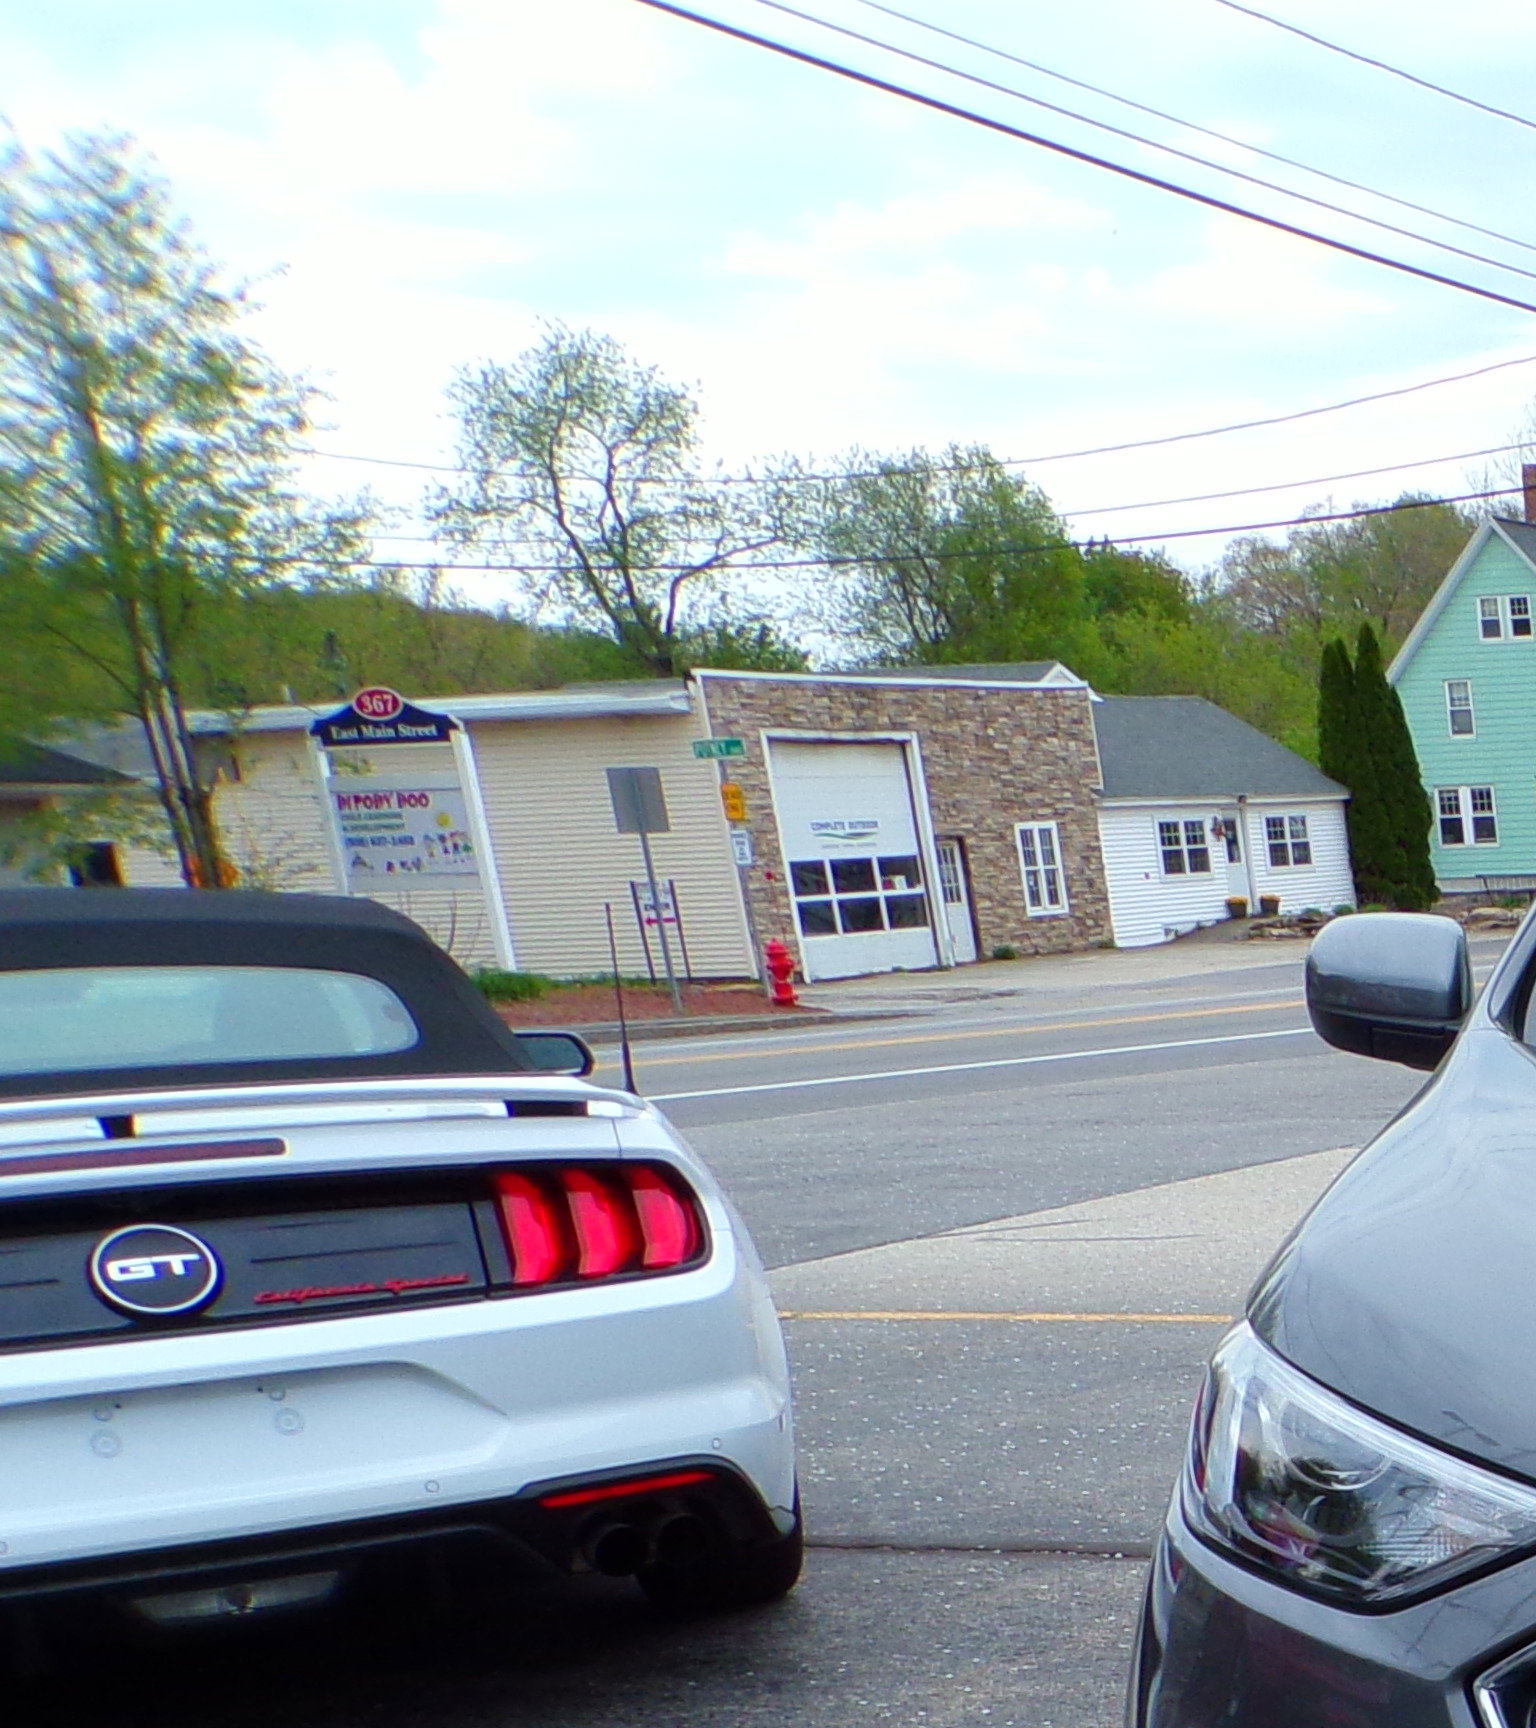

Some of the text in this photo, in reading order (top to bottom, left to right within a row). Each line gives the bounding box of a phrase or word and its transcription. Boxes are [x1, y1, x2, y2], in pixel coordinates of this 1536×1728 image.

[361, 693, 393, 713] 367
[330, 723, 438, 740] East Main Street
[106, 1253, 200, 1282] GT
